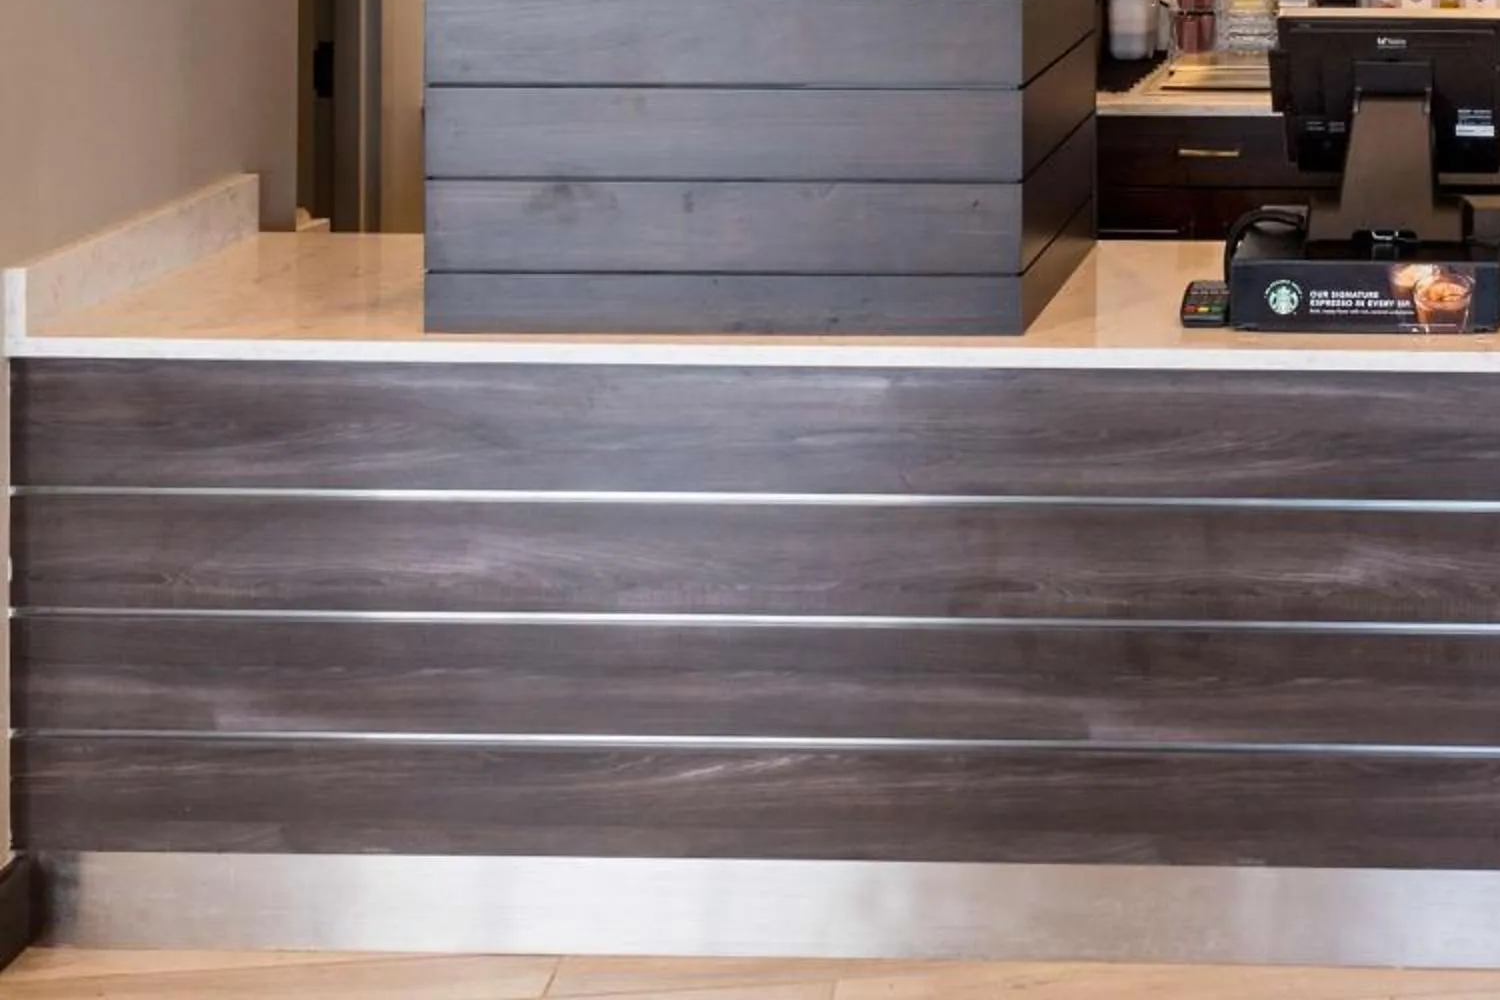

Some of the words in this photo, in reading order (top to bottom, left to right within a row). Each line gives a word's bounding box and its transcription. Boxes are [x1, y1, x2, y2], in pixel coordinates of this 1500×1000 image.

[1309, 290, 1328, 299] OUR
[1331, 290, 1379, 299] SIGNATURE
[1309, 299, 1353, 307] ESPRESSO
[1367, 299, 1394, 308] EVERY
